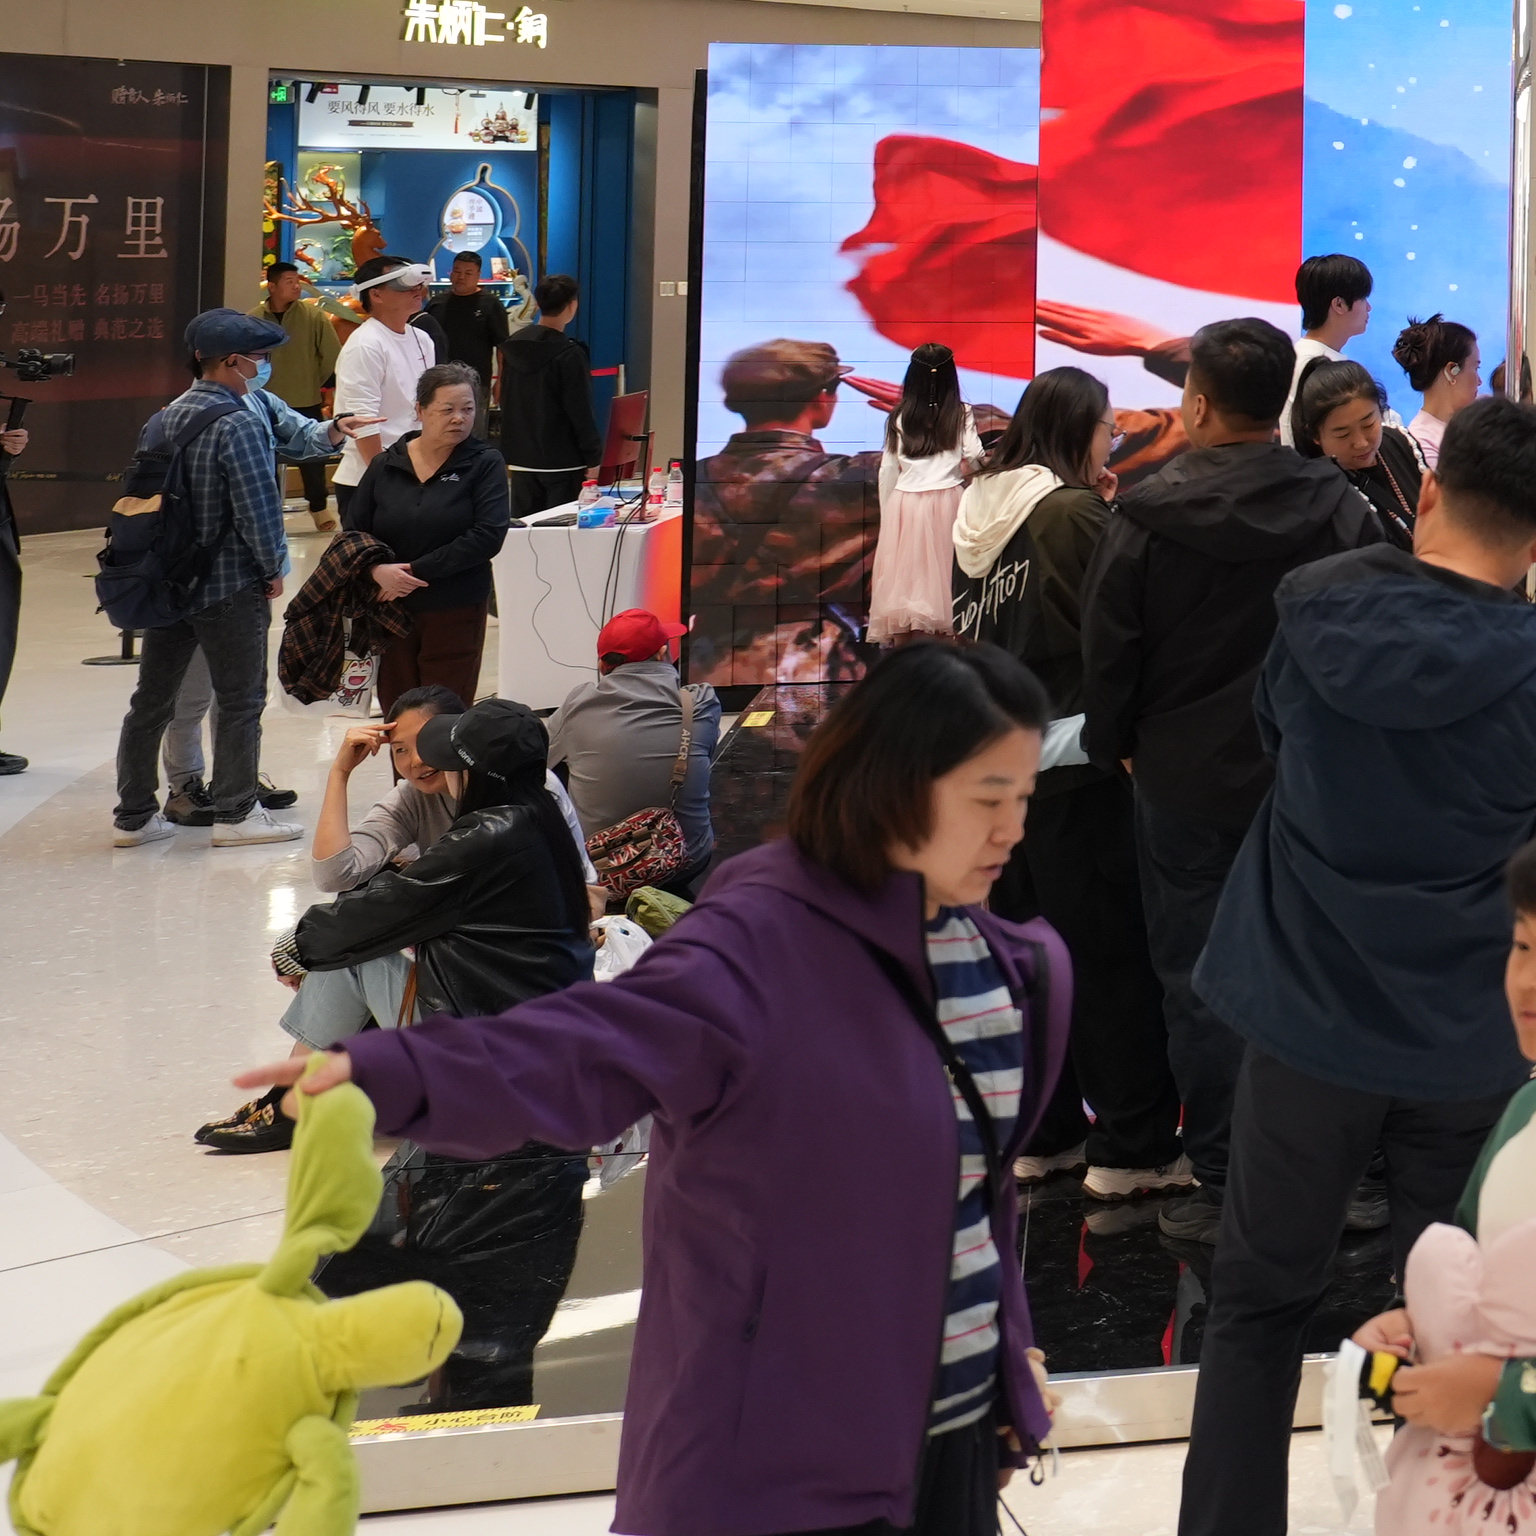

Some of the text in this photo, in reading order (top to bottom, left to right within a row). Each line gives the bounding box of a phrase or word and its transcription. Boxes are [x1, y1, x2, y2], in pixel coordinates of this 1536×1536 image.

[13, 282, 166, 308] 一马当先 名扬万里
[425, 1410, 523, 1427] 小心台阶
